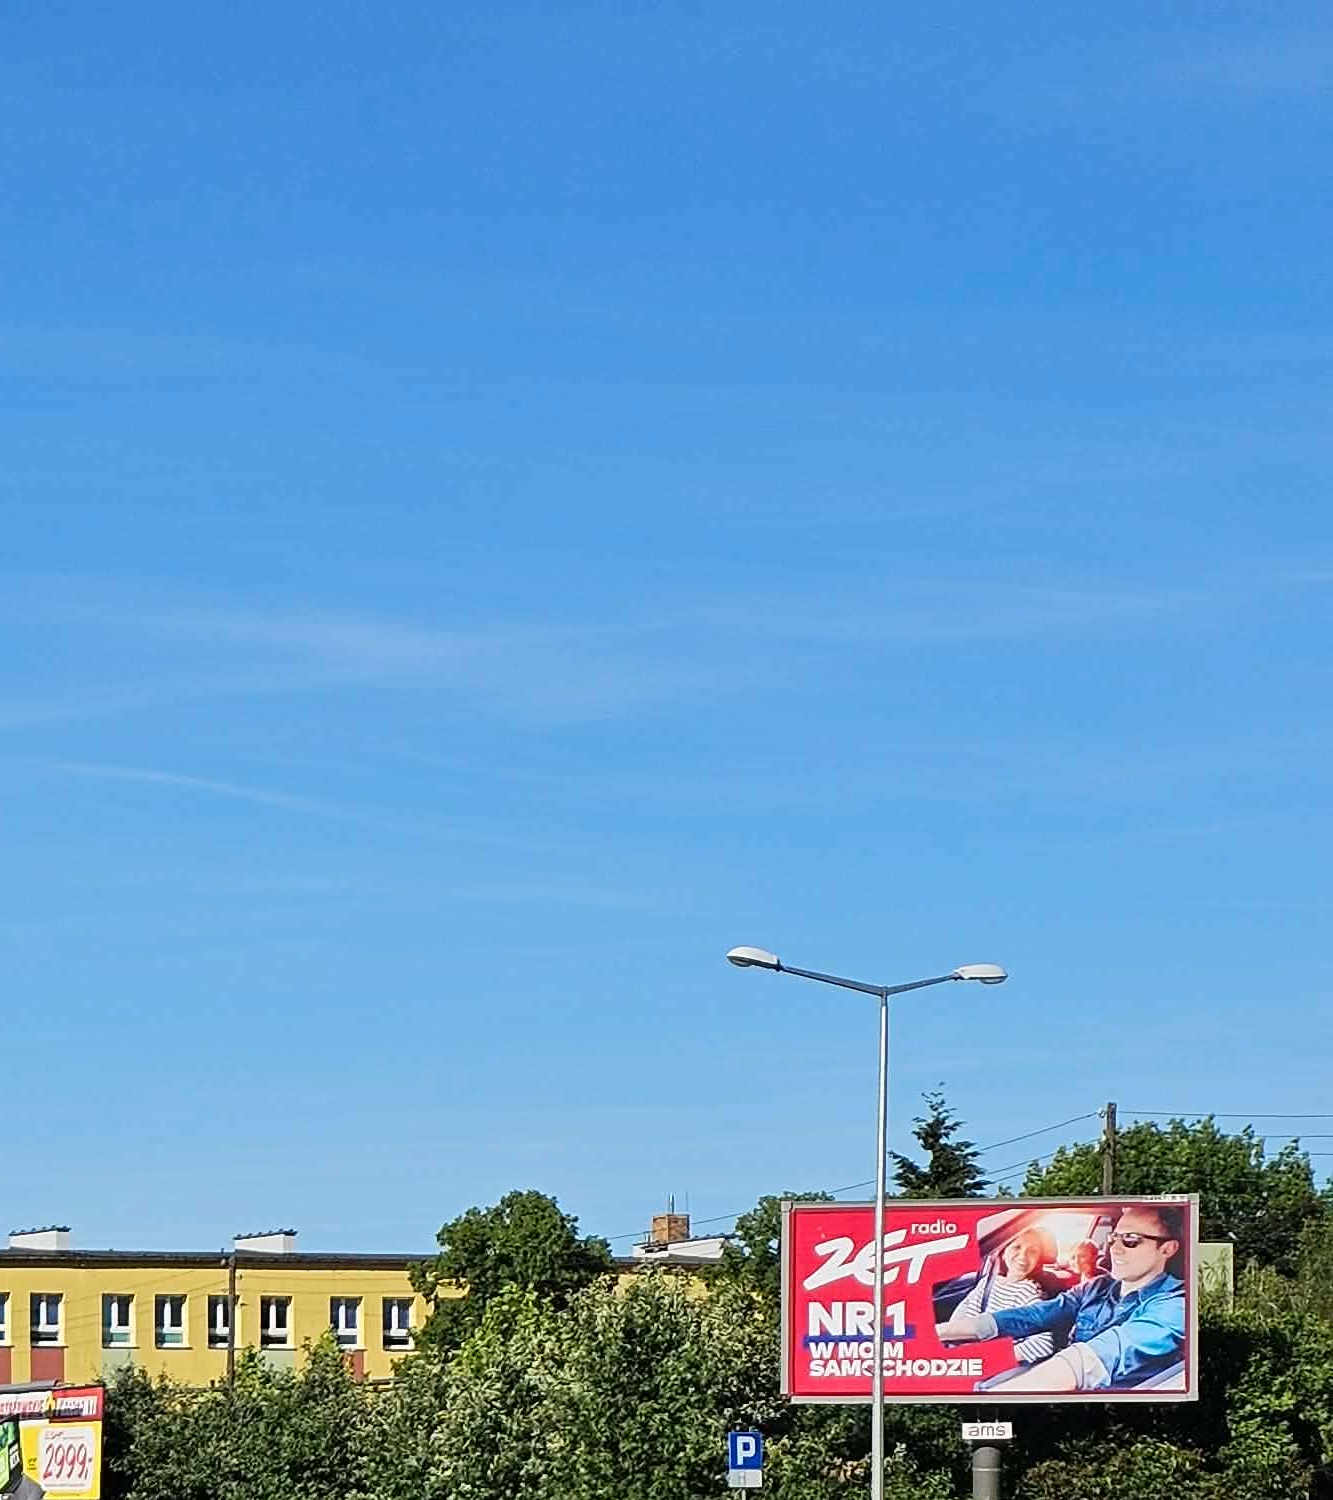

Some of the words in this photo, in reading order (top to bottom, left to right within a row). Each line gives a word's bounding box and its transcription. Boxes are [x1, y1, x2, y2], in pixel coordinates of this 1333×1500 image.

[911, 1219, 957, 1235] radio
[803, 1229, 969, 1290] ZET
[808, 1301, 875, 1336] NR
[886, 1300, 906, 1336] 1
[809, 1342, 838, 1359] W
[839, 1342, 904, 1359] MOM
[967, 1425, 1006, 1437] ams
[736, 1436, 756, 1466] P
